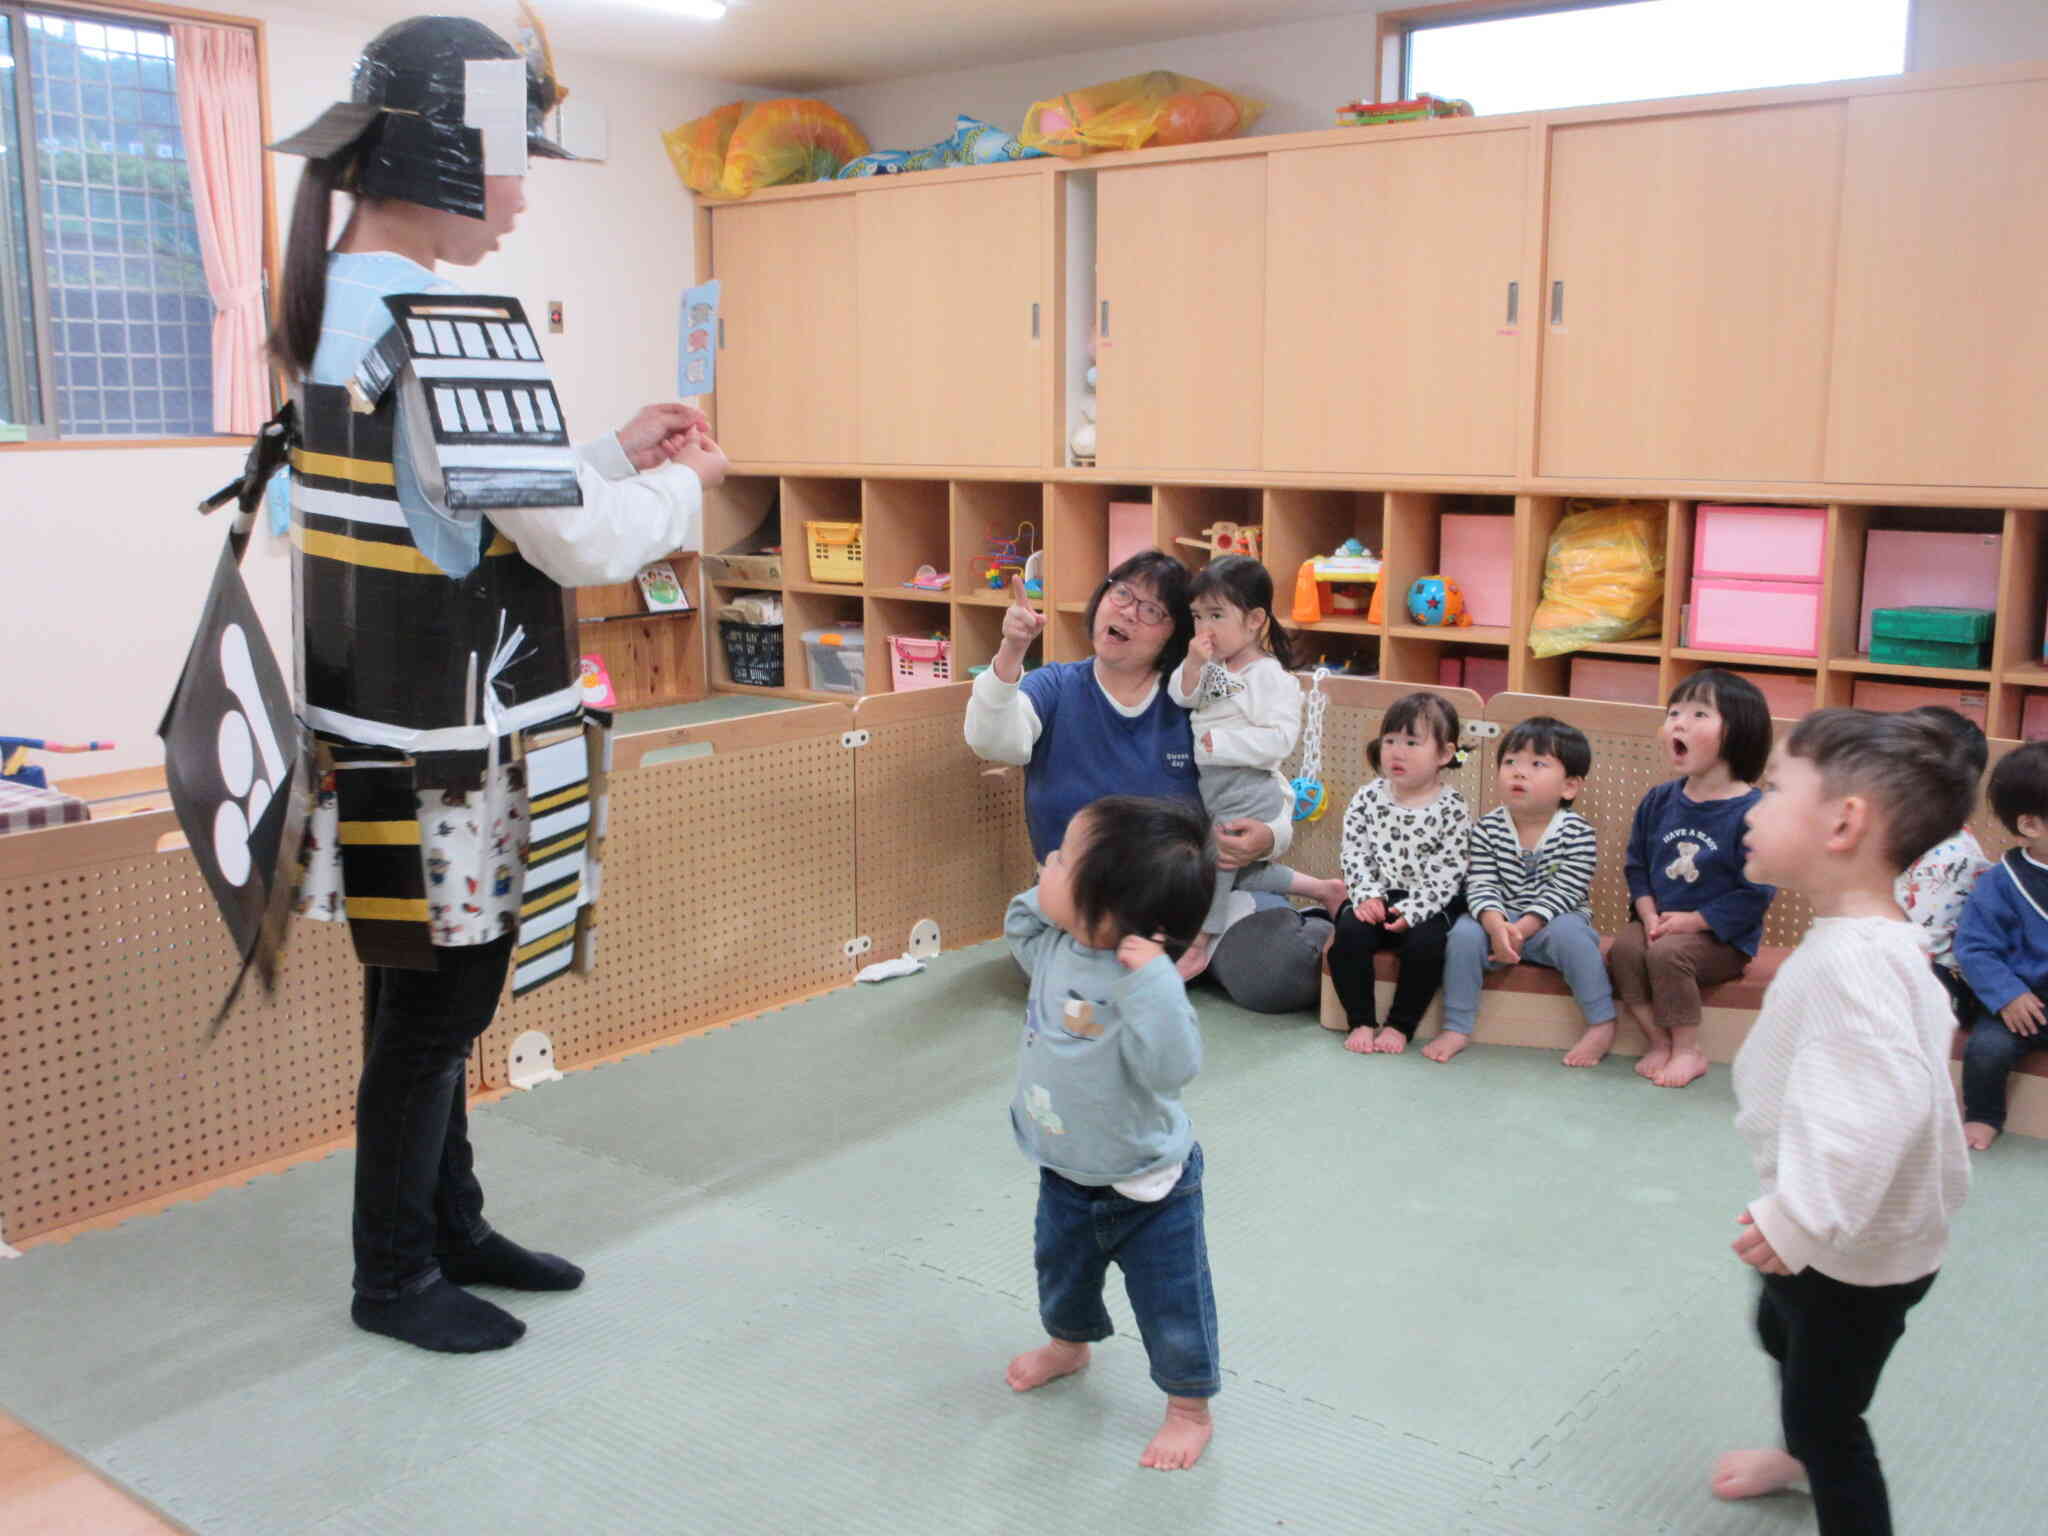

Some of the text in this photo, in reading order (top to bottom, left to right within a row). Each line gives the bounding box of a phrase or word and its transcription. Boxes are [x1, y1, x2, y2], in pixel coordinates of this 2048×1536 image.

[1663, 828, 1718, 850] HAVE A BLAST
